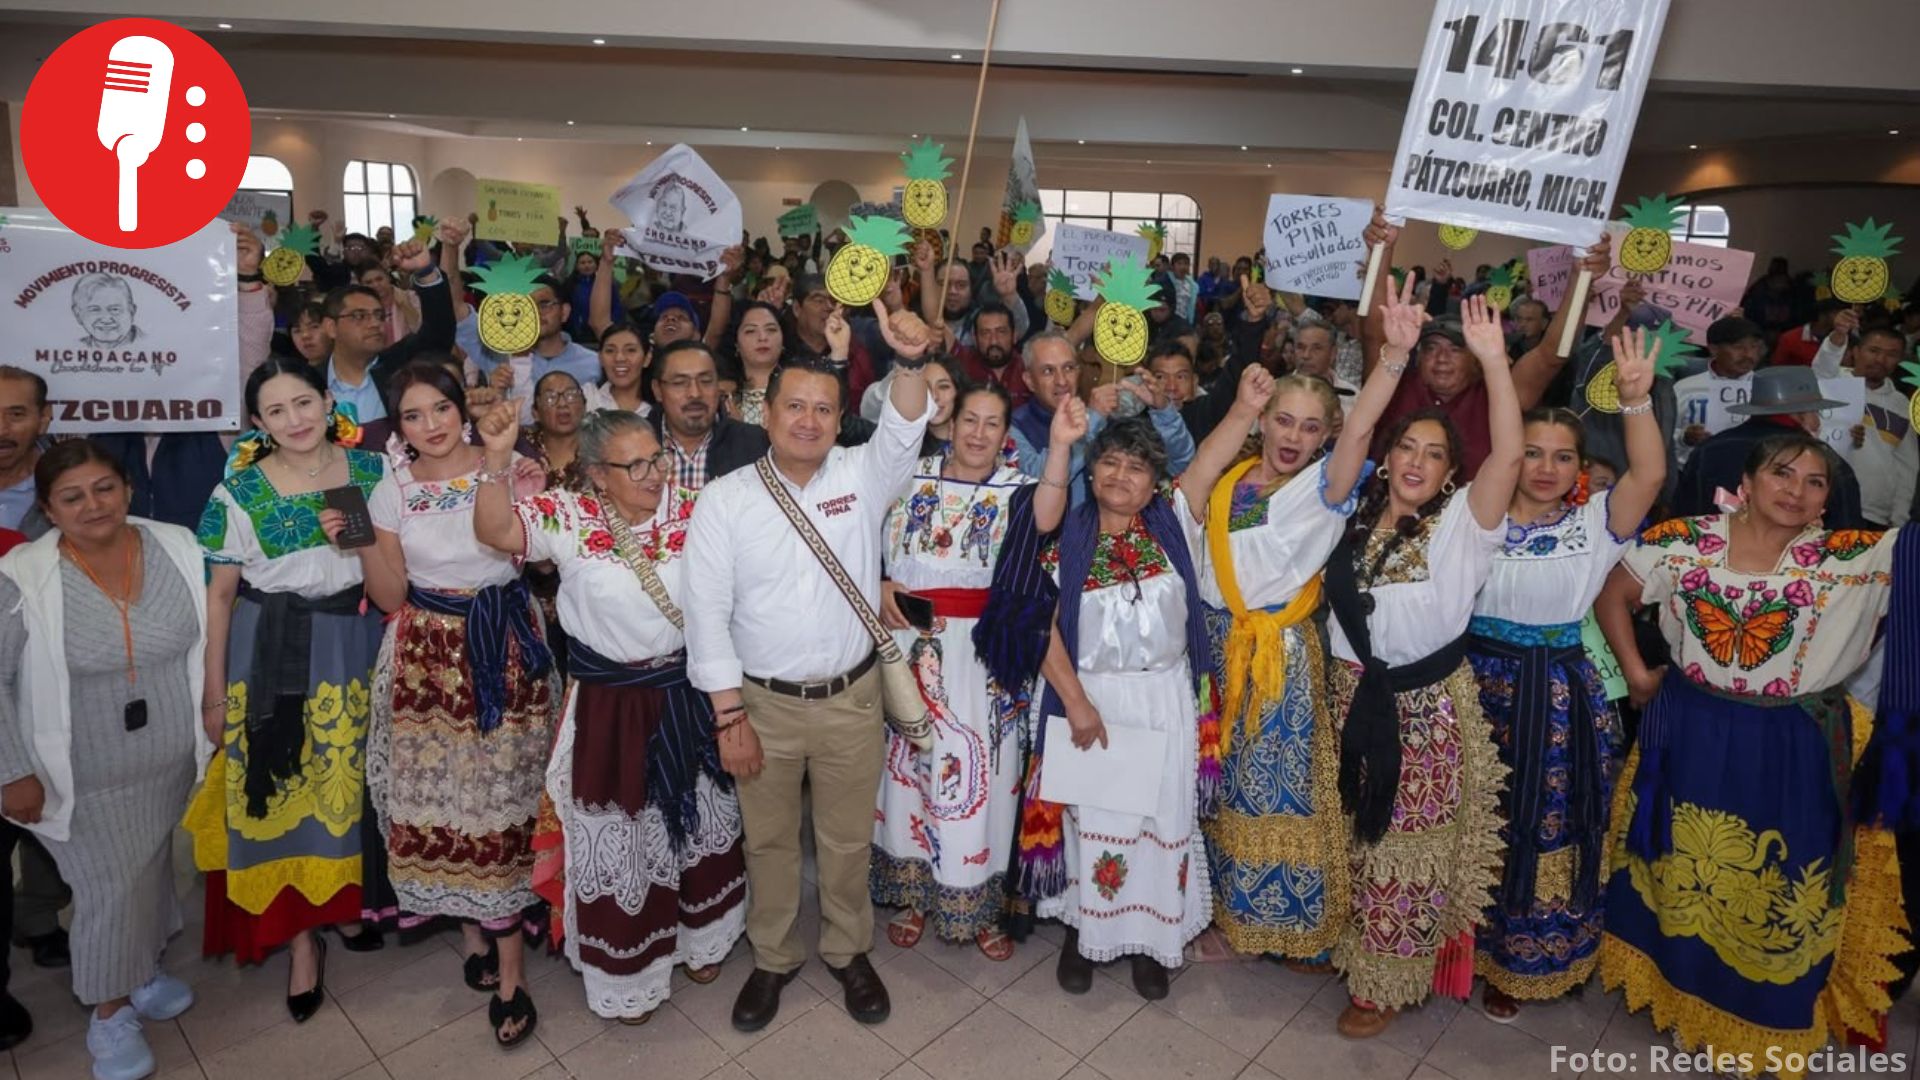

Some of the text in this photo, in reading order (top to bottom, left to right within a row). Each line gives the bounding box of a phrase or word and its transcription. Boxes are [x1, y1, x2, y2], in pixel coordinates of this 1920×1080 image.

[1443, 14, 1635, 91] 1461
[1428, 98, 1484, 142] COL.
[1402, 149, 1608, 219] PÁTZCUARO, MICH.
[1271, 202, 1342, 234] TORRES
[1285, 220, 1338, 248] PIÑA
[14, 261, 192, 312] MOVIMIENTO PROGRESISTA
[35, 349, 178, 364] MICHOACANO
[816, 493, 857, 512] TORRES
